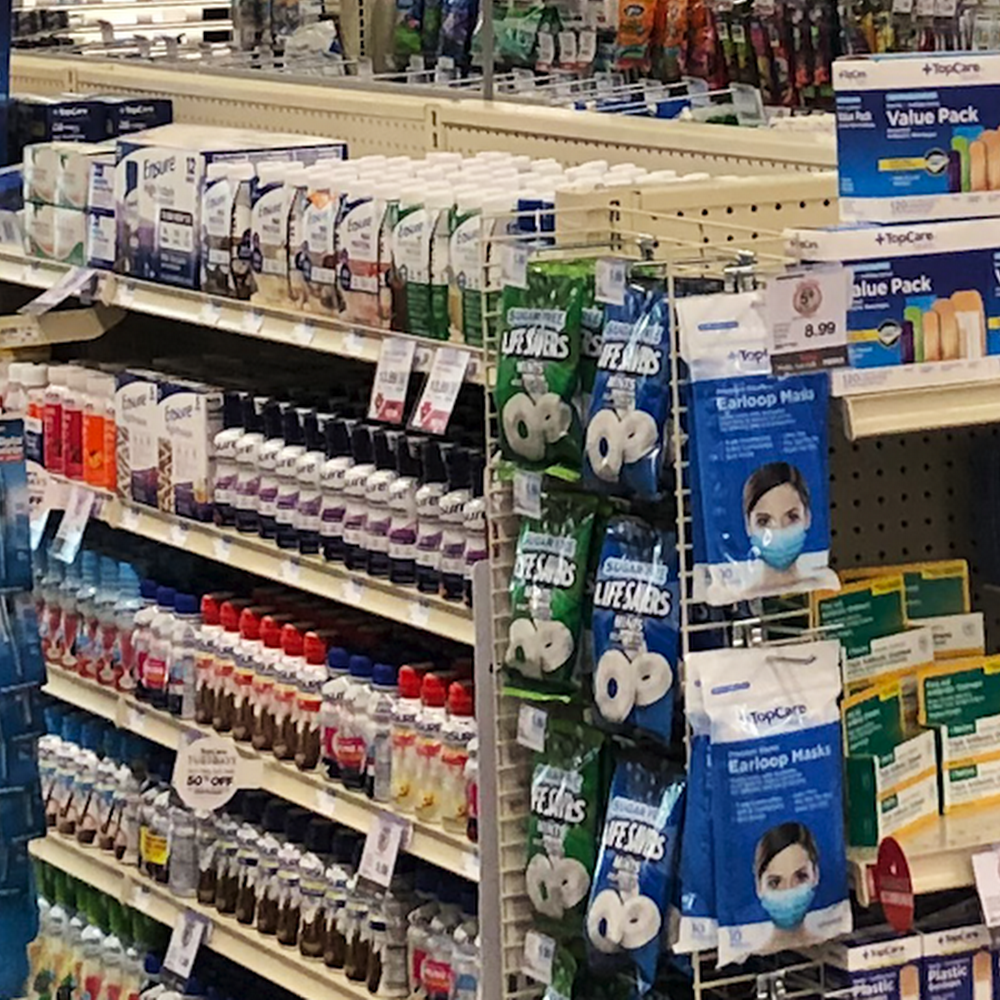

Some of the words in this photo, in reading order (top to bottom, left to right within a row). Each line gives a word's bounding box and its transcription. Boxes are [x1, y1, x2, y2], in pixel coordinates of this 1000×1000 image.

[886, 108, 936, 127] Value
[937, 105, 980, 123] Pack
[143, 156, 177, 180] Ensure
[852, 279, 892, 297] alue
[893, 275, 932, 294] Pack
[805, 321, 836, 338] 8.99
[750, 705, 808, 725] TopCare
[728, 754, 789, 775] Earloop
[791, 743, 832, 763] Masks
[927, 965, 968, 982] Plastic
